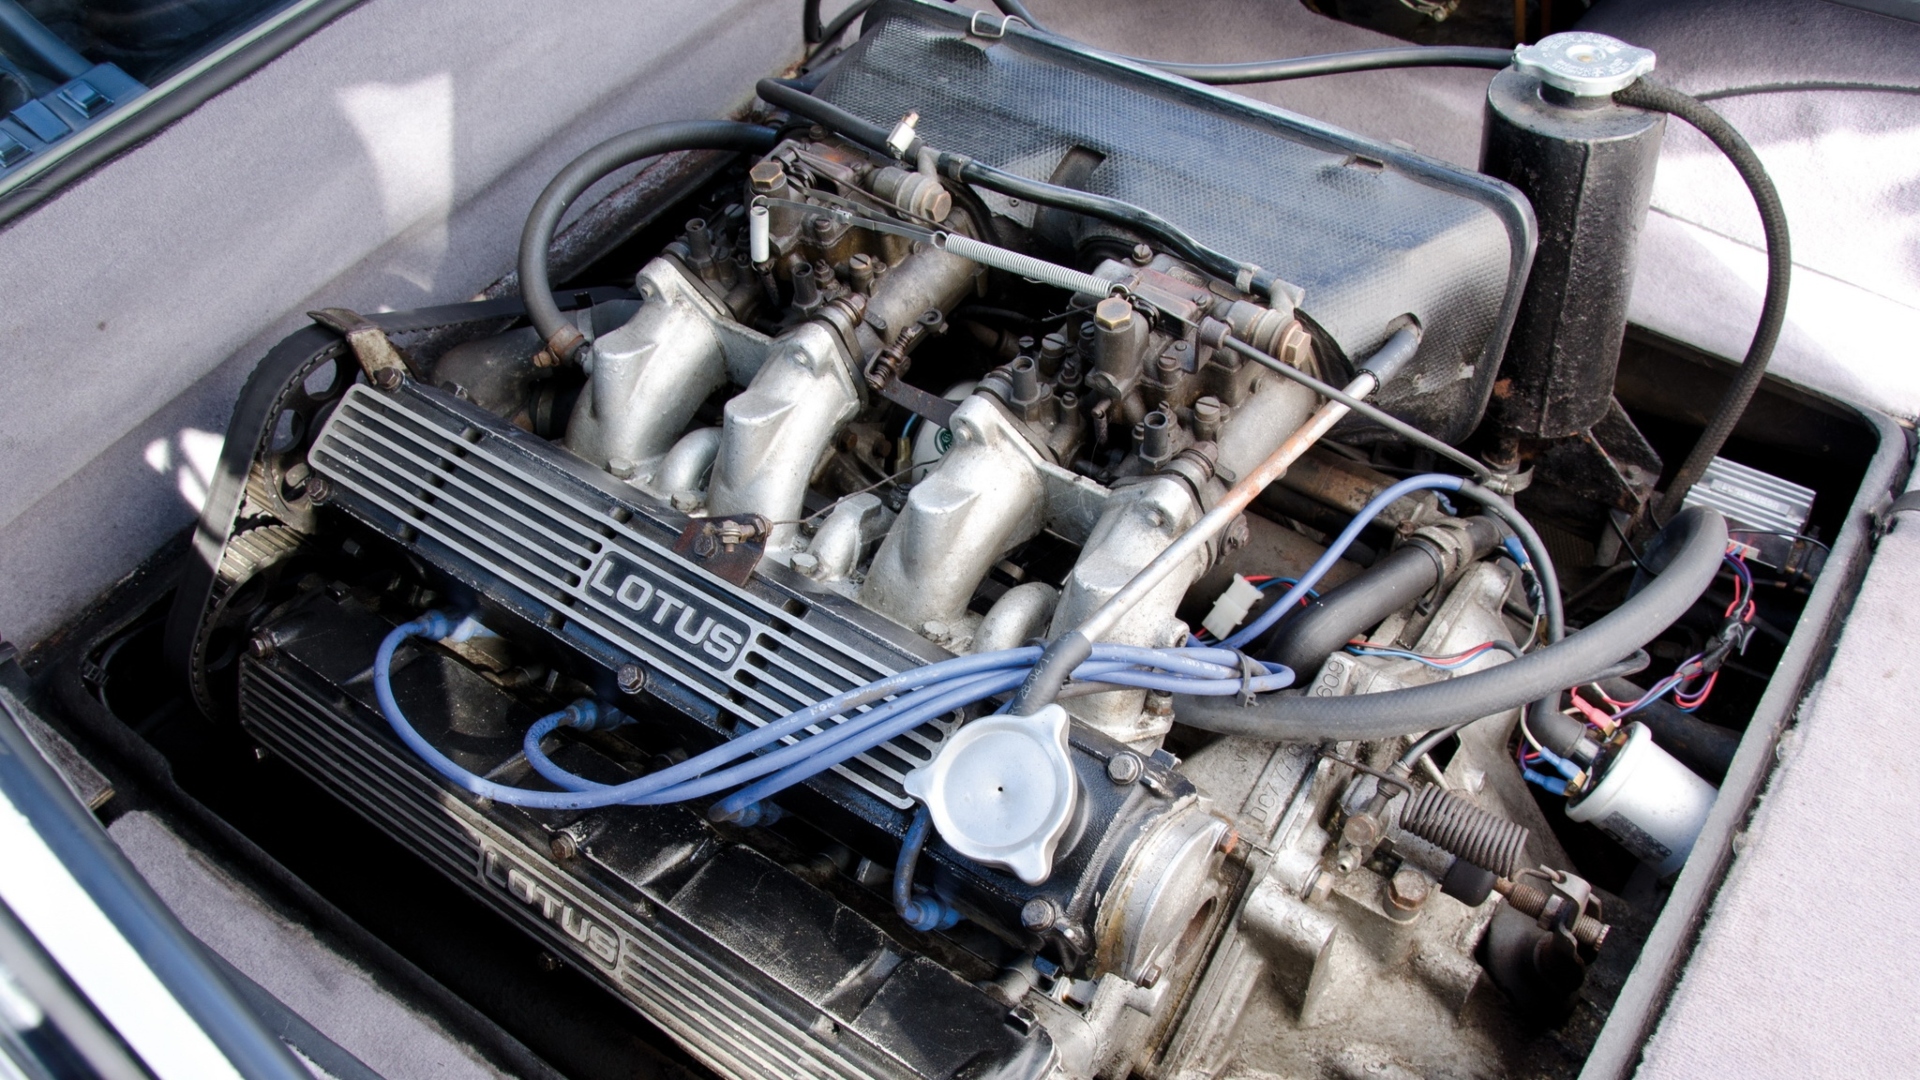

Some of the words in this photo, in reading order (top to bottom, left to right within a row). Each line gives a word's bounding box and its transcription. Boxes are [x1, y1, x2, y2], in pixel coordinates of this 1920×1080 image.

[590, 559, 742, 663] LOTUS
[1018, 652, 1054, 699] 28/04/11
[1316, 660, 1345, 697] 609
[485, 851, 618, 963] LOTUS
